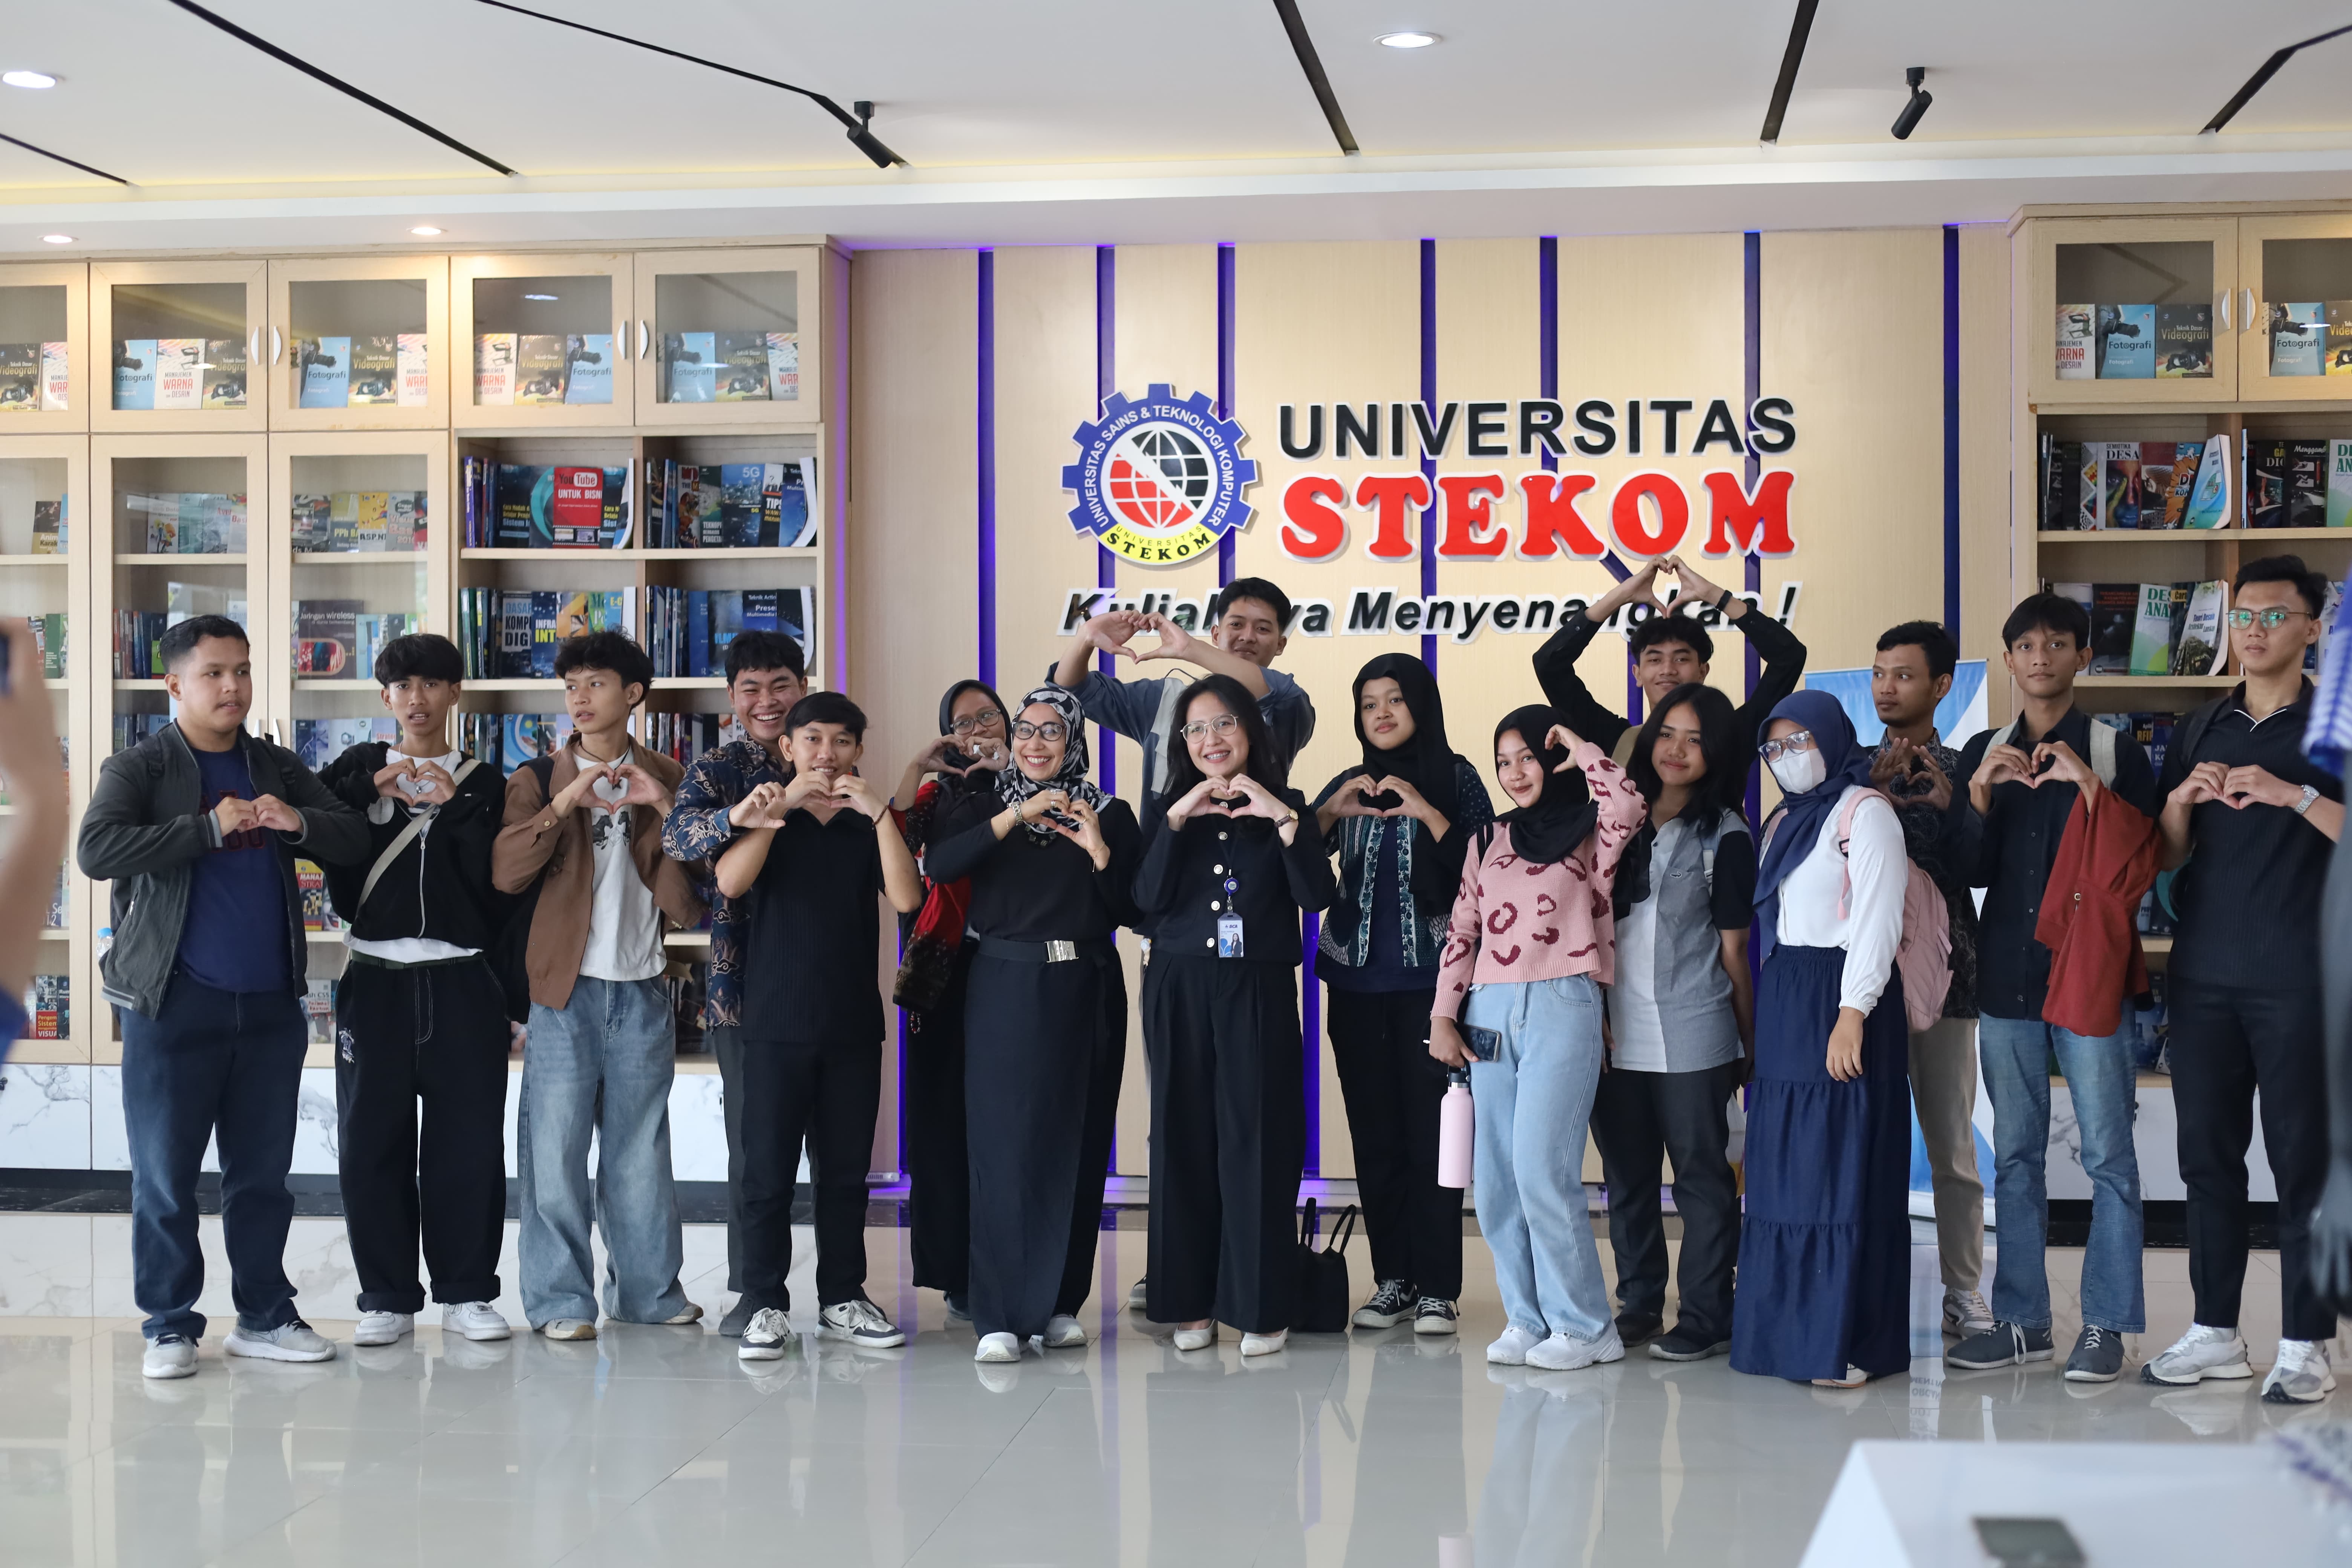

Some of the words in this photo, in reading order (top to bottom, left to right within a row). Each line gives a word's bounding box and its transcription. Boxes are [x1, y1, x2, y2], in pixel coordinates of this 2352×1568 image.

[2161, 328, 2209, 341] Videografi
[2109, 340, 2151, 351] Fotografi
[2277, 338, 2319, 349] Fotografi
[353, 358, 395, 371] Videografi
[308, 371, 346, 380] Fotografi
[573, 367, 611, 377] Fotografi
[674, 368, 712, 377] Fotografi
[164, 378, 193, 390] WARNA
[476, 375, 505, 386] WARNA
[1281, 398, 1795, 458] UNIVERSITAS
[1084, 440, 1110, 528] UNIVERSITAS
[1101, 410, 1139, 442] SAINS
[1141, 407, 1151, 418] &
[1153, 405, 1220, 450] TEKNOLOGI
[1208, 449, 1234, 527] KOMPUTER
[743, 467, 760, 478] 5G
[558, 489, 582, 499] UNTUK
[1282, 472, 1794, 557] STEKOM
[1116, 526, 1202, 547] UNIVERSITAS
[1107, 533, 1211, 560] STEKOM
[300, 612, 325, 620] Jaringan
[326, 611, 355, 620] wireless
[2193, 613, 2203, 622] Teori
[2203, 612, 2215, 621] Desain
